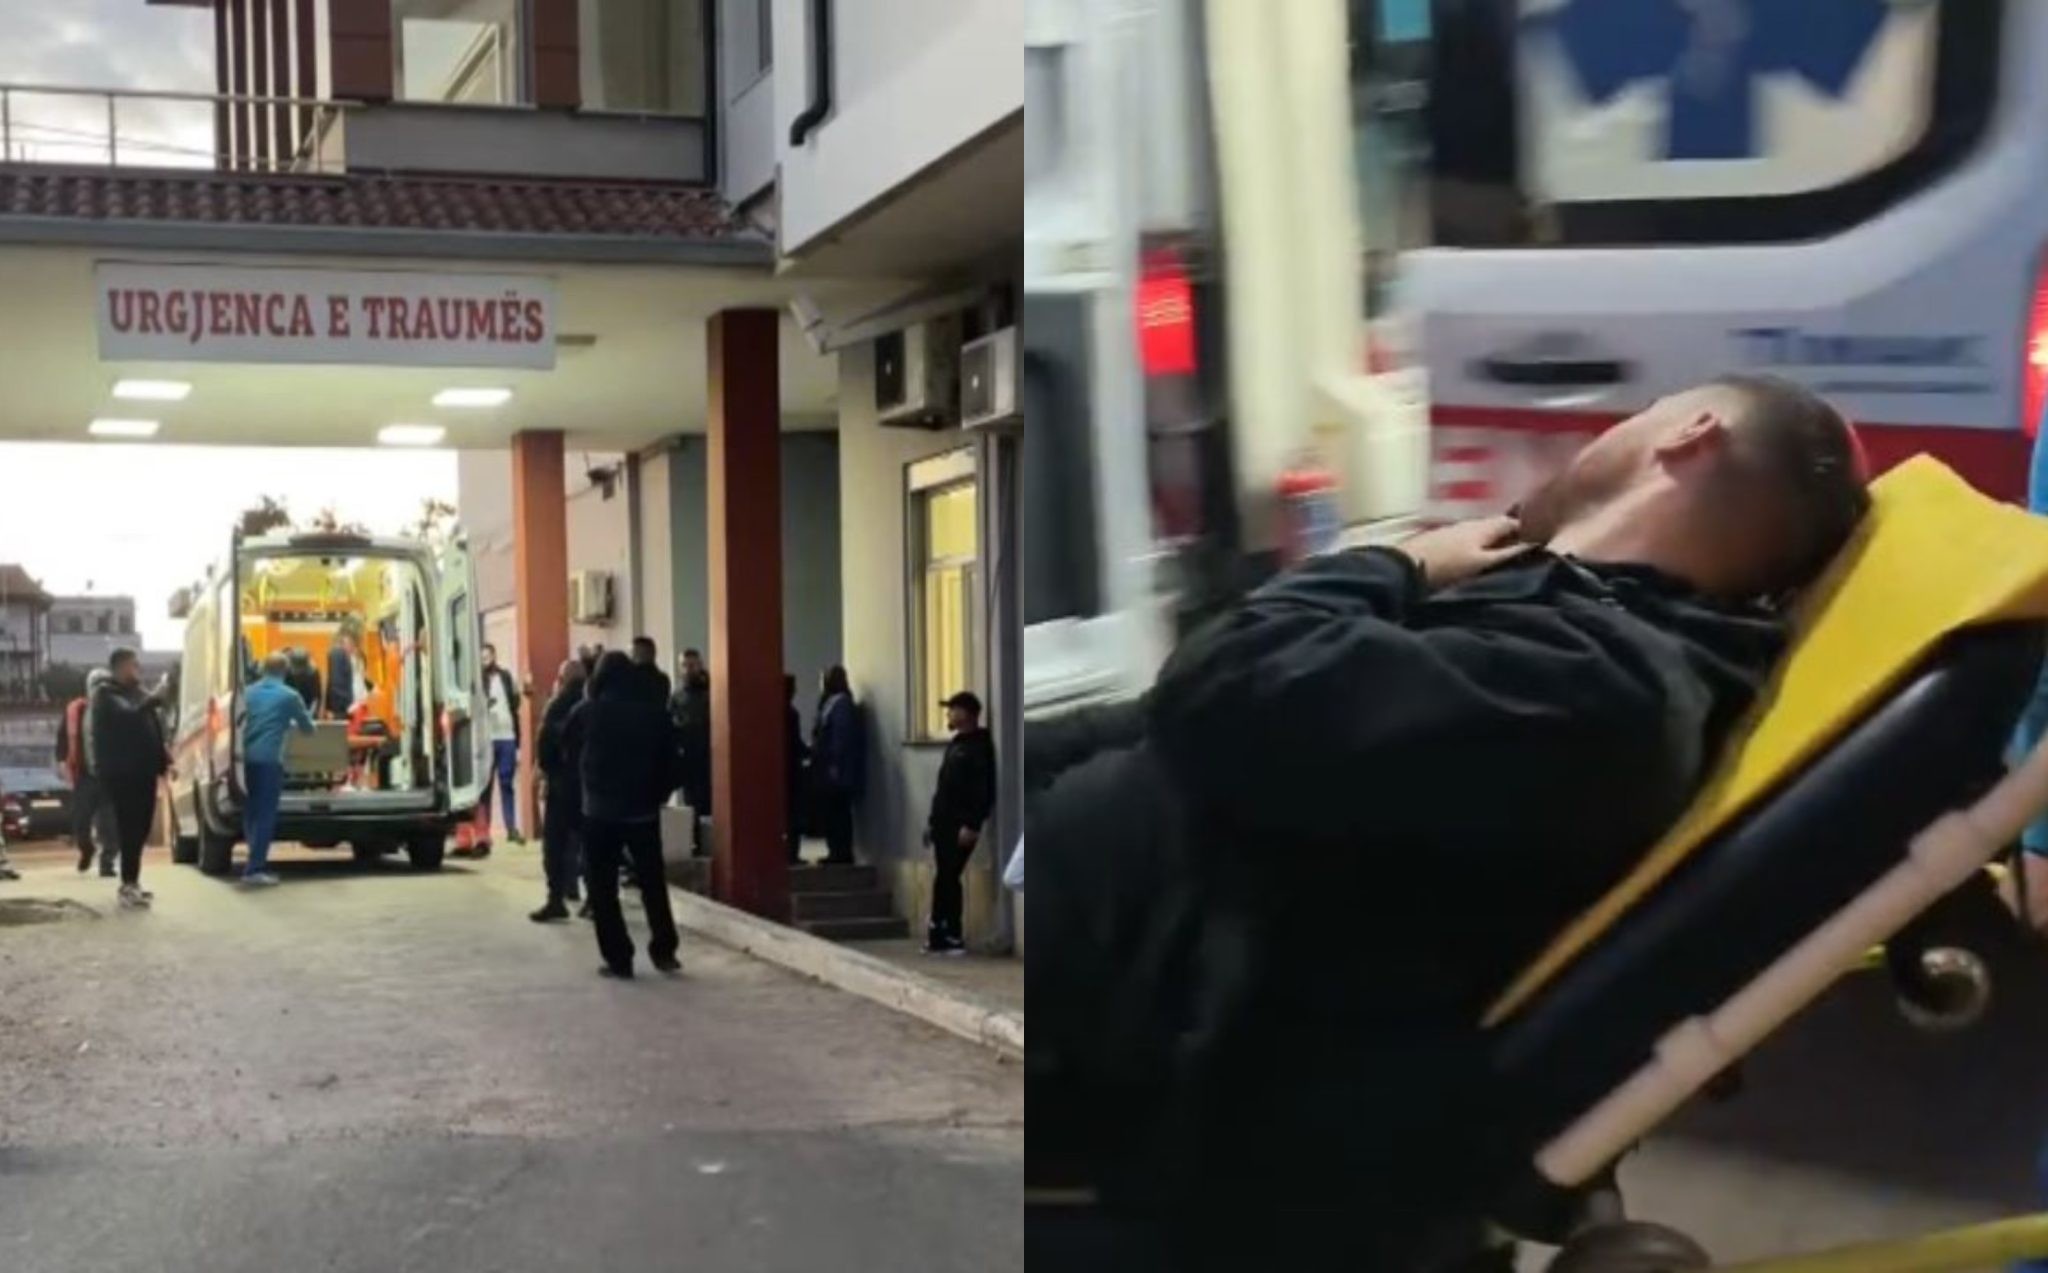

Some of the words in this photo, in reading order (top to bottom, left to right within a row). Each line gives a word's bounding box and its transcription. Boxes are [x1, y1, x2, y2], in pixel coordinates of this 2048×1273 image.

[108, 289, 314, 343] URGJENCA
[327, 295, 350, 338] E
[362, 290, 545, 343] TRAUMËS
